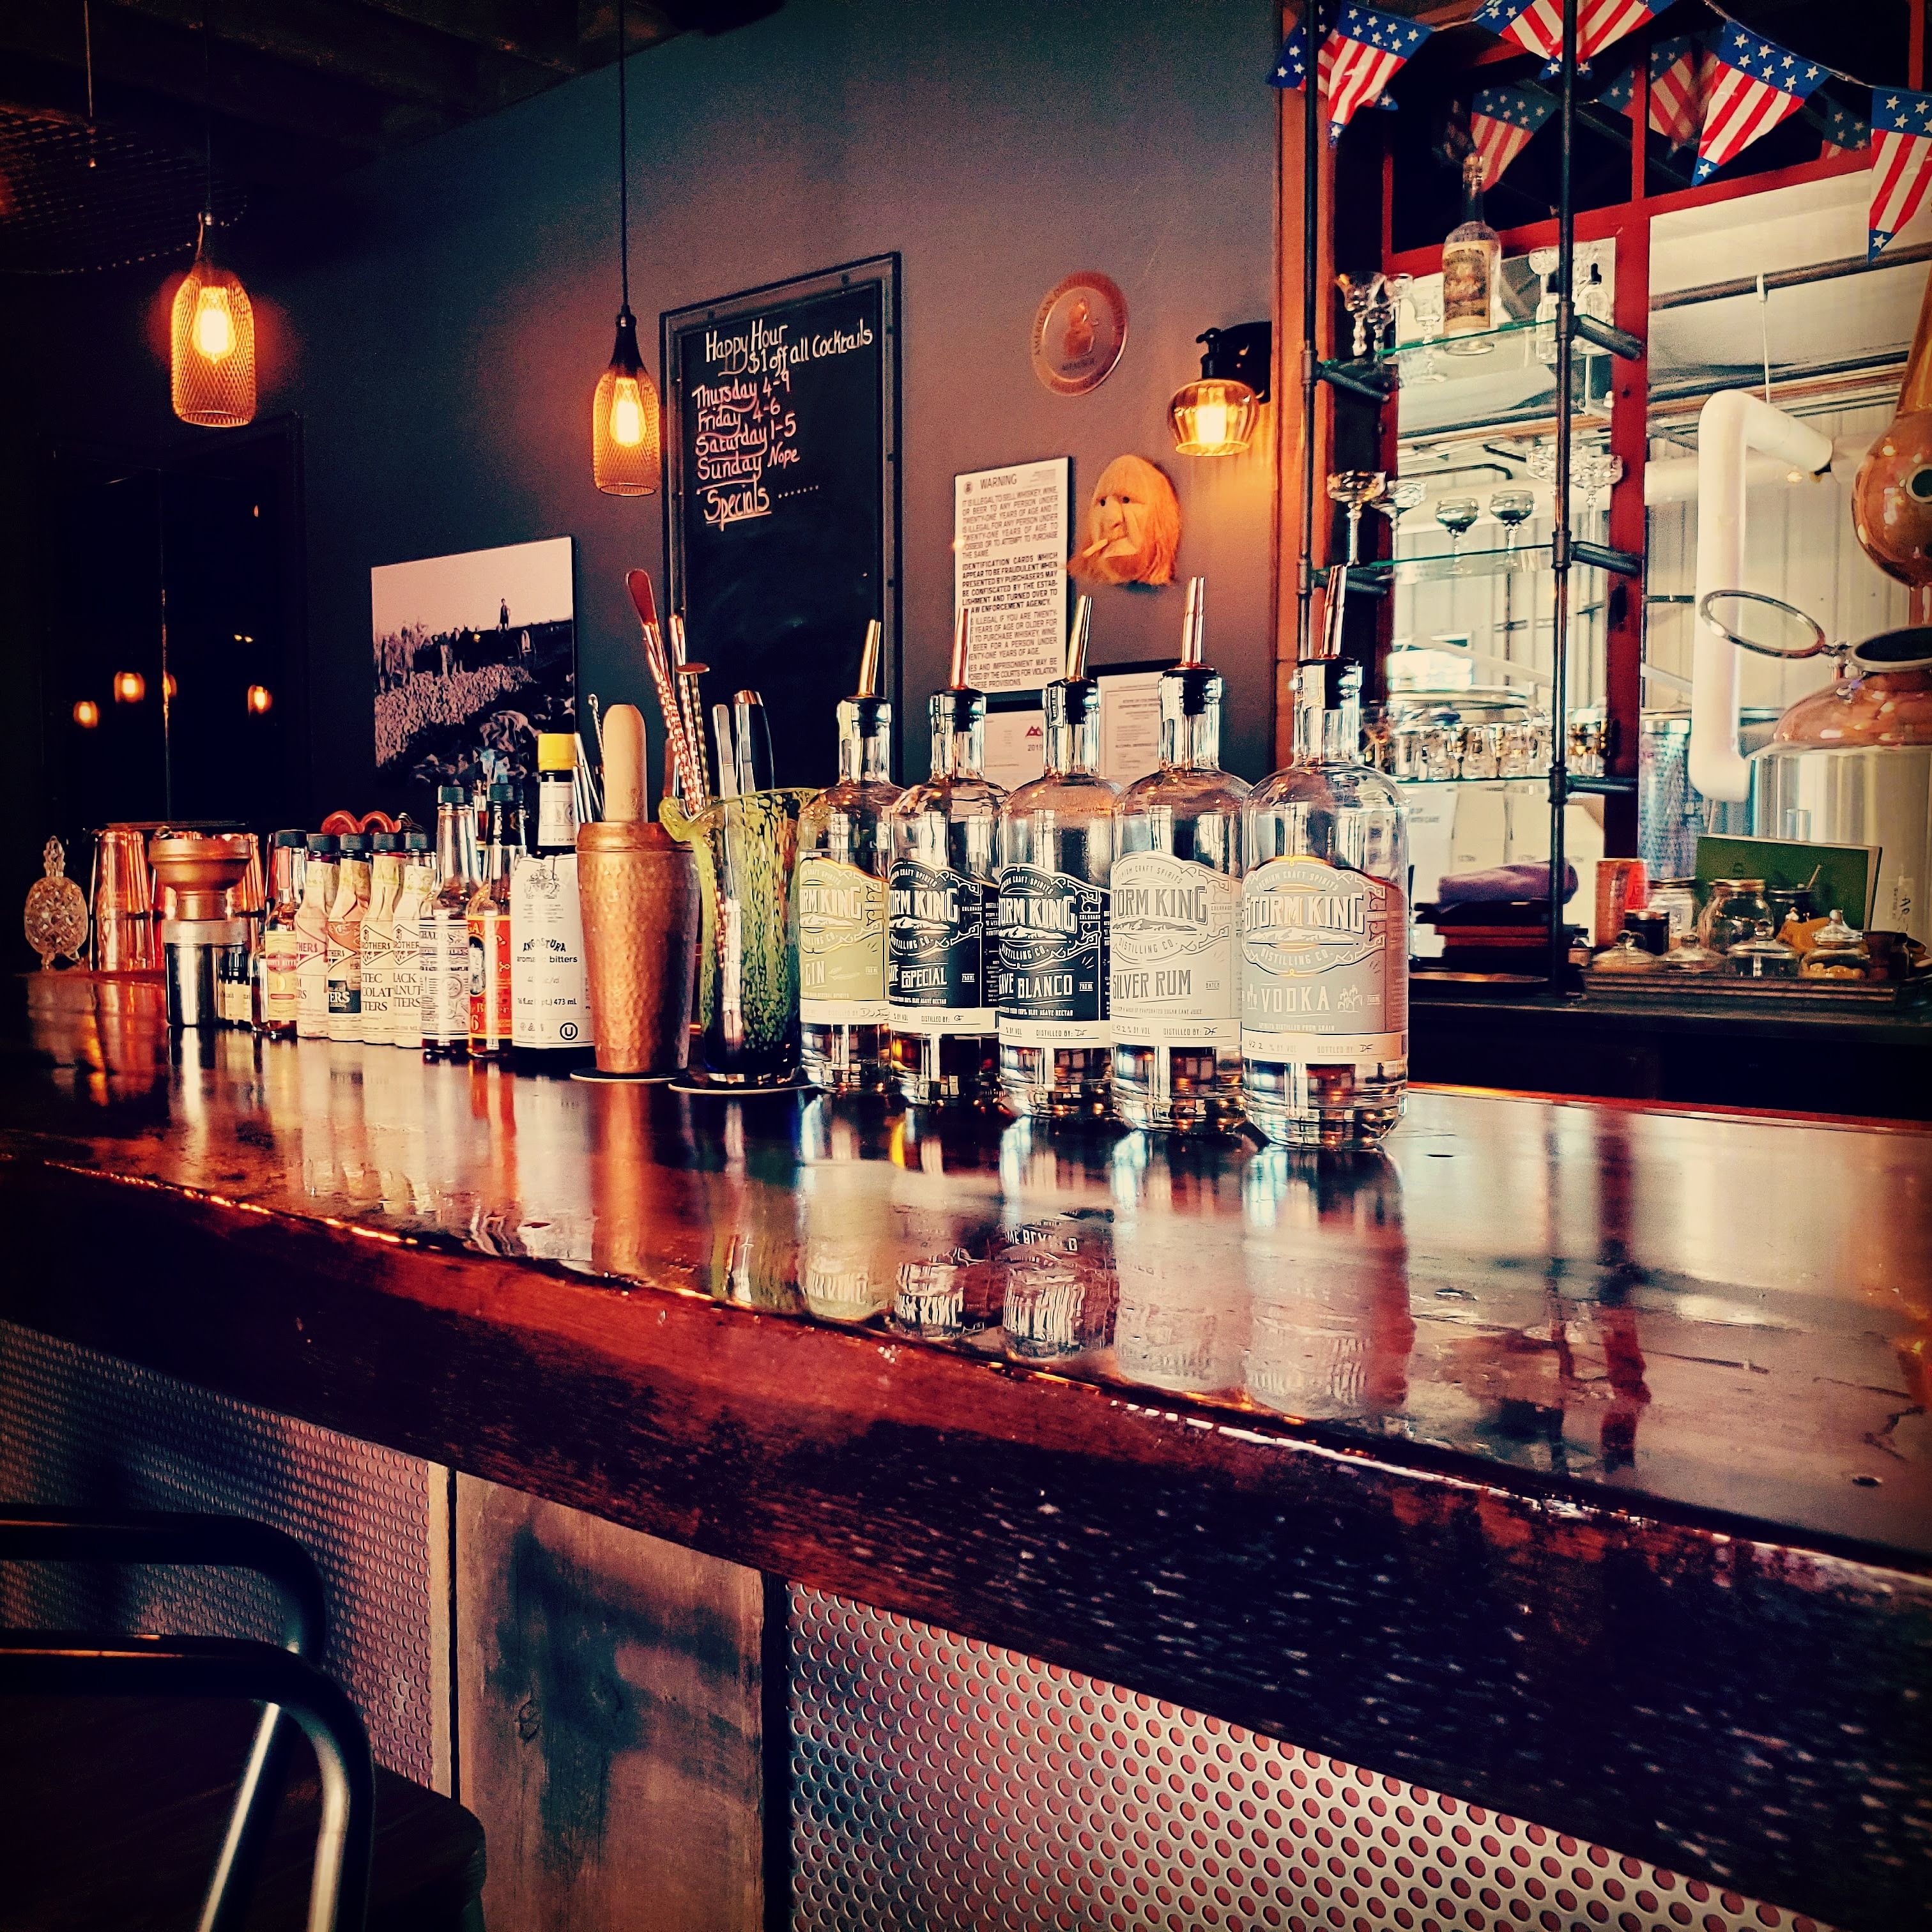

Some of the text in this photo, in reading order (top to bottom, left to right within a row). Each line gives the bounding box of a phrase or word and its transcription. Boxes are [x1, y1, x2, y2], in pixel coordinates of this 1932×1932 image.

[706, 318, 788, 376] Happy Hour
[747, 348, 767, 374] $1
[769, 346, 789, 377] off
[790, 337, 809, 364] all
[691, 370, 790, 413] Thursday 4-9
[698, 396, 781, 439] Friday 4-6
[695, 412, 797, 461] Saturday 1-5
[696, 441, 800, 488] Sunday Nope
[981, 474, 1017, 489] WARNING
[703, 473, 770, 532] Specials
[1002, 528, 1021, 536] YEARS
[963, 555, 1033, 571] IDENTIFICATION CARDS
[963, 571, 983, 579] APPEAR
[1002, 564, 1039, 574] FRAUDULENT
[963, 578, 995, 588] PRESENTED
[972, 585, 1011, 595] CONFISCATED
[981, 602, 1024, 612] ENFORCEMENT
[916, 870, 937, 887] SPIRITS
[1029, 878, 1054, 894] SPIRITS
[1156, 868, 1183, 884] SPIRITS
[1255, 870, 1339, 892] PREMIUM CRAFT SPIRITS
[821, 887, 861, 920] KING
[915, 888, 959, 924] KING
[1029, 895, 1077, 934] KING
[1112, 886, 1208, 925] TORM KING
[1245, 892, 1364, 935] STORM KING
[921, 935, 933, 946] CO.
[1001, 943, 1049, 960] DISTILLING CO.
[1119, 939, 1178, 954] DISTILLING CO.
[1261, 949, 1335, 966] DISTILLING CO.
[394, 973, 417, 983] LACK
[806, 960, 825, 986] GIN
[901, 967, 947, 988] ESPECIAL
[1017, 974, 1073, 999] BLANCO
[1112, 969, 1191, 1000] SILVER RUM
[1261, 986, 1330, 1013] VODKA
